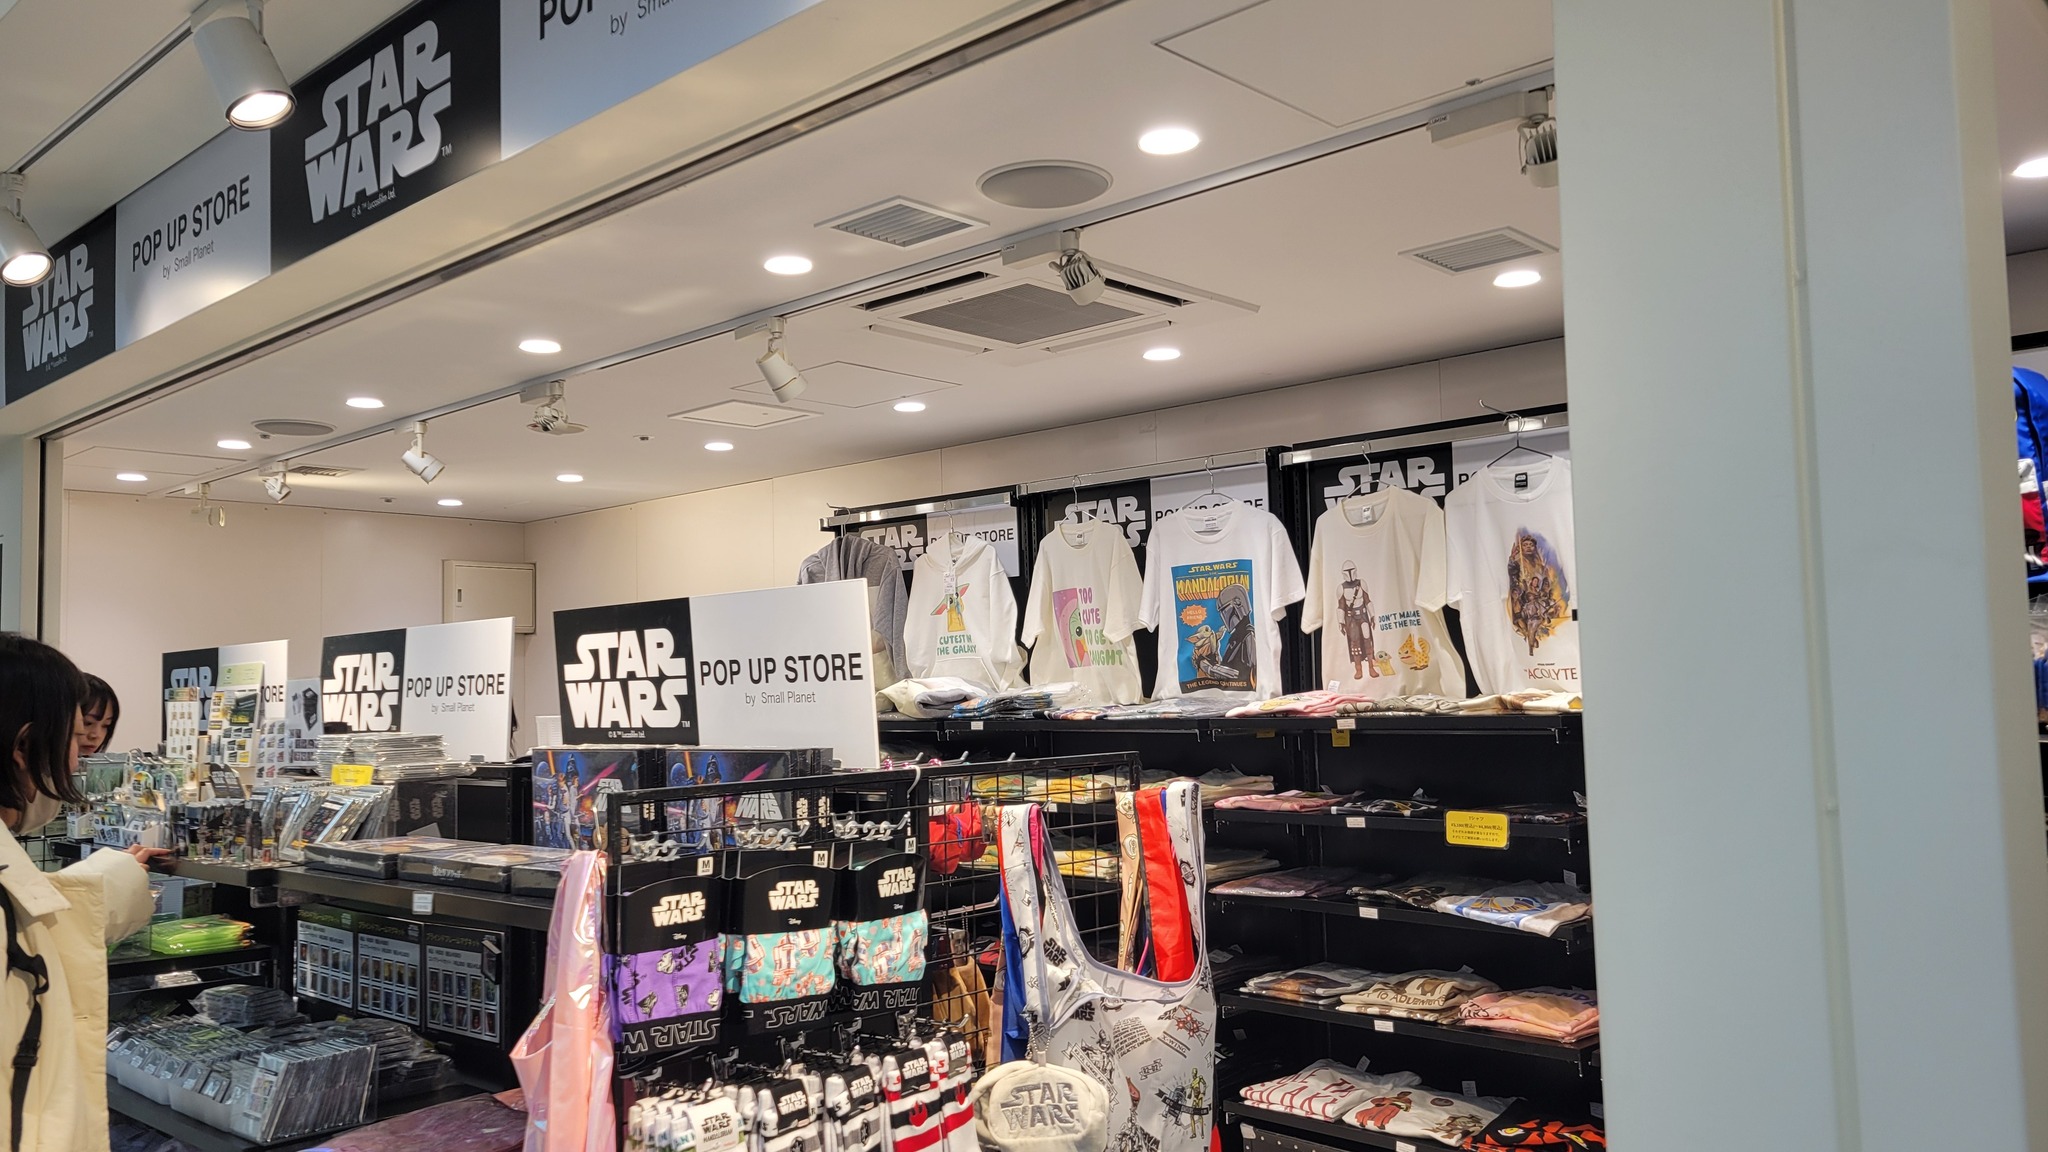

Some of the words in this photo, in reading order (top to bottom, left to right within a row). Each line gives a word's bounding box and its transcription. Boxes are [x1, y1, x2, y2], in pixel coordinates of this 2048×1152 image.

[609, 12, 628, 36] by
[305, 20, 452, 163] STAR
[305, 81, 452, 224] WARS
[132, 228, 162, 273] POP
[167, 213, 188, 253] UP
[192, 174, 250, 238] STORE
[162, 264, 172, 280] by
[174, 250, 192, 272] Small
[192, 240, 215, 263] Planet
[22, 243, 94, 327] STAR
[22, 287, 94, 372] WARS
[1324, 456, 1446, 498] STAR
[1054, 495, 1146, 526] STAR
[1188, 564, 1212, 573] STAR
[1212, 561, 1238, 571] WARS
[1079, 587, 1093, 604] TOO
[1175, 574, 1250, 599] MANDALORIAN
[1082, 608, 1101, 625] CUTE
[1380, 623, 1393, 631] USE
[1393, 620, 1409, 629] THE
[1085, 629, 1094, 645] TO
[563, 627, 687, 681] STAR
[936, 647, 950, 656] THE
[323, 651, 400, 693] STAR
[700, 658, 741, 687] POP
[748, 657, 776, 685] UP
[784, 652, 863, 683] STORE
[1527, 667, 1578, 680] ACOLYTE
[164, 665, 216, 702] STAR
[406, 677, 432, 698] POP
[436, 676, 454, 697] UP
[457, 673, 505, 697] STORE
[564, 678, 689, 728] WARS
[745, 692, 756, 706] by
[761, 691, 785, 704] Small
[787, 690, 816, 703] Planet
[322, 691, 400, 731] WARS
[431, 704, 439, 715] by
[441, 702, 457, 712] Small
[457, 702, 475, 712] Planet
[734, 797, 784, 820] WARS
[908, 840, 915, 848] M
[702, 860, 711, 869] M
[817, 853, 825, 861] M
[877, 866, 916, 885] STAR
[768, 880, 819, 897] STAR
[877, 879, 916, 898] WARS
[652, 891, 706, 912] STAR
[768, 893, 819, 911] WARS
[652, 904, 706, 927] WARS
[650, 1016, 721, 1048] STAR
[948, 1040, 966, 1054] STAR
[949, 1046, 967, 1061] WARS
[1162, 1034, 1187, 1054] X-WING
[901, 1057, 929, 1073] STAR
[902, 1065, 929, 1080] WARS
[849, 1075, 873, 1093] STAR
[850, 1082, 873, 1099] WARS
[777, 1090, 807, 1107] STAR
[1000, 1082, 1079, 1109] STAR
[778, 1097, 808, 1116] WARS
[701, 1112, 731, 1127] STAR
[703, 1119, 731, 1134] WARS
[1001, 1103, 1079, 1131] WARS
